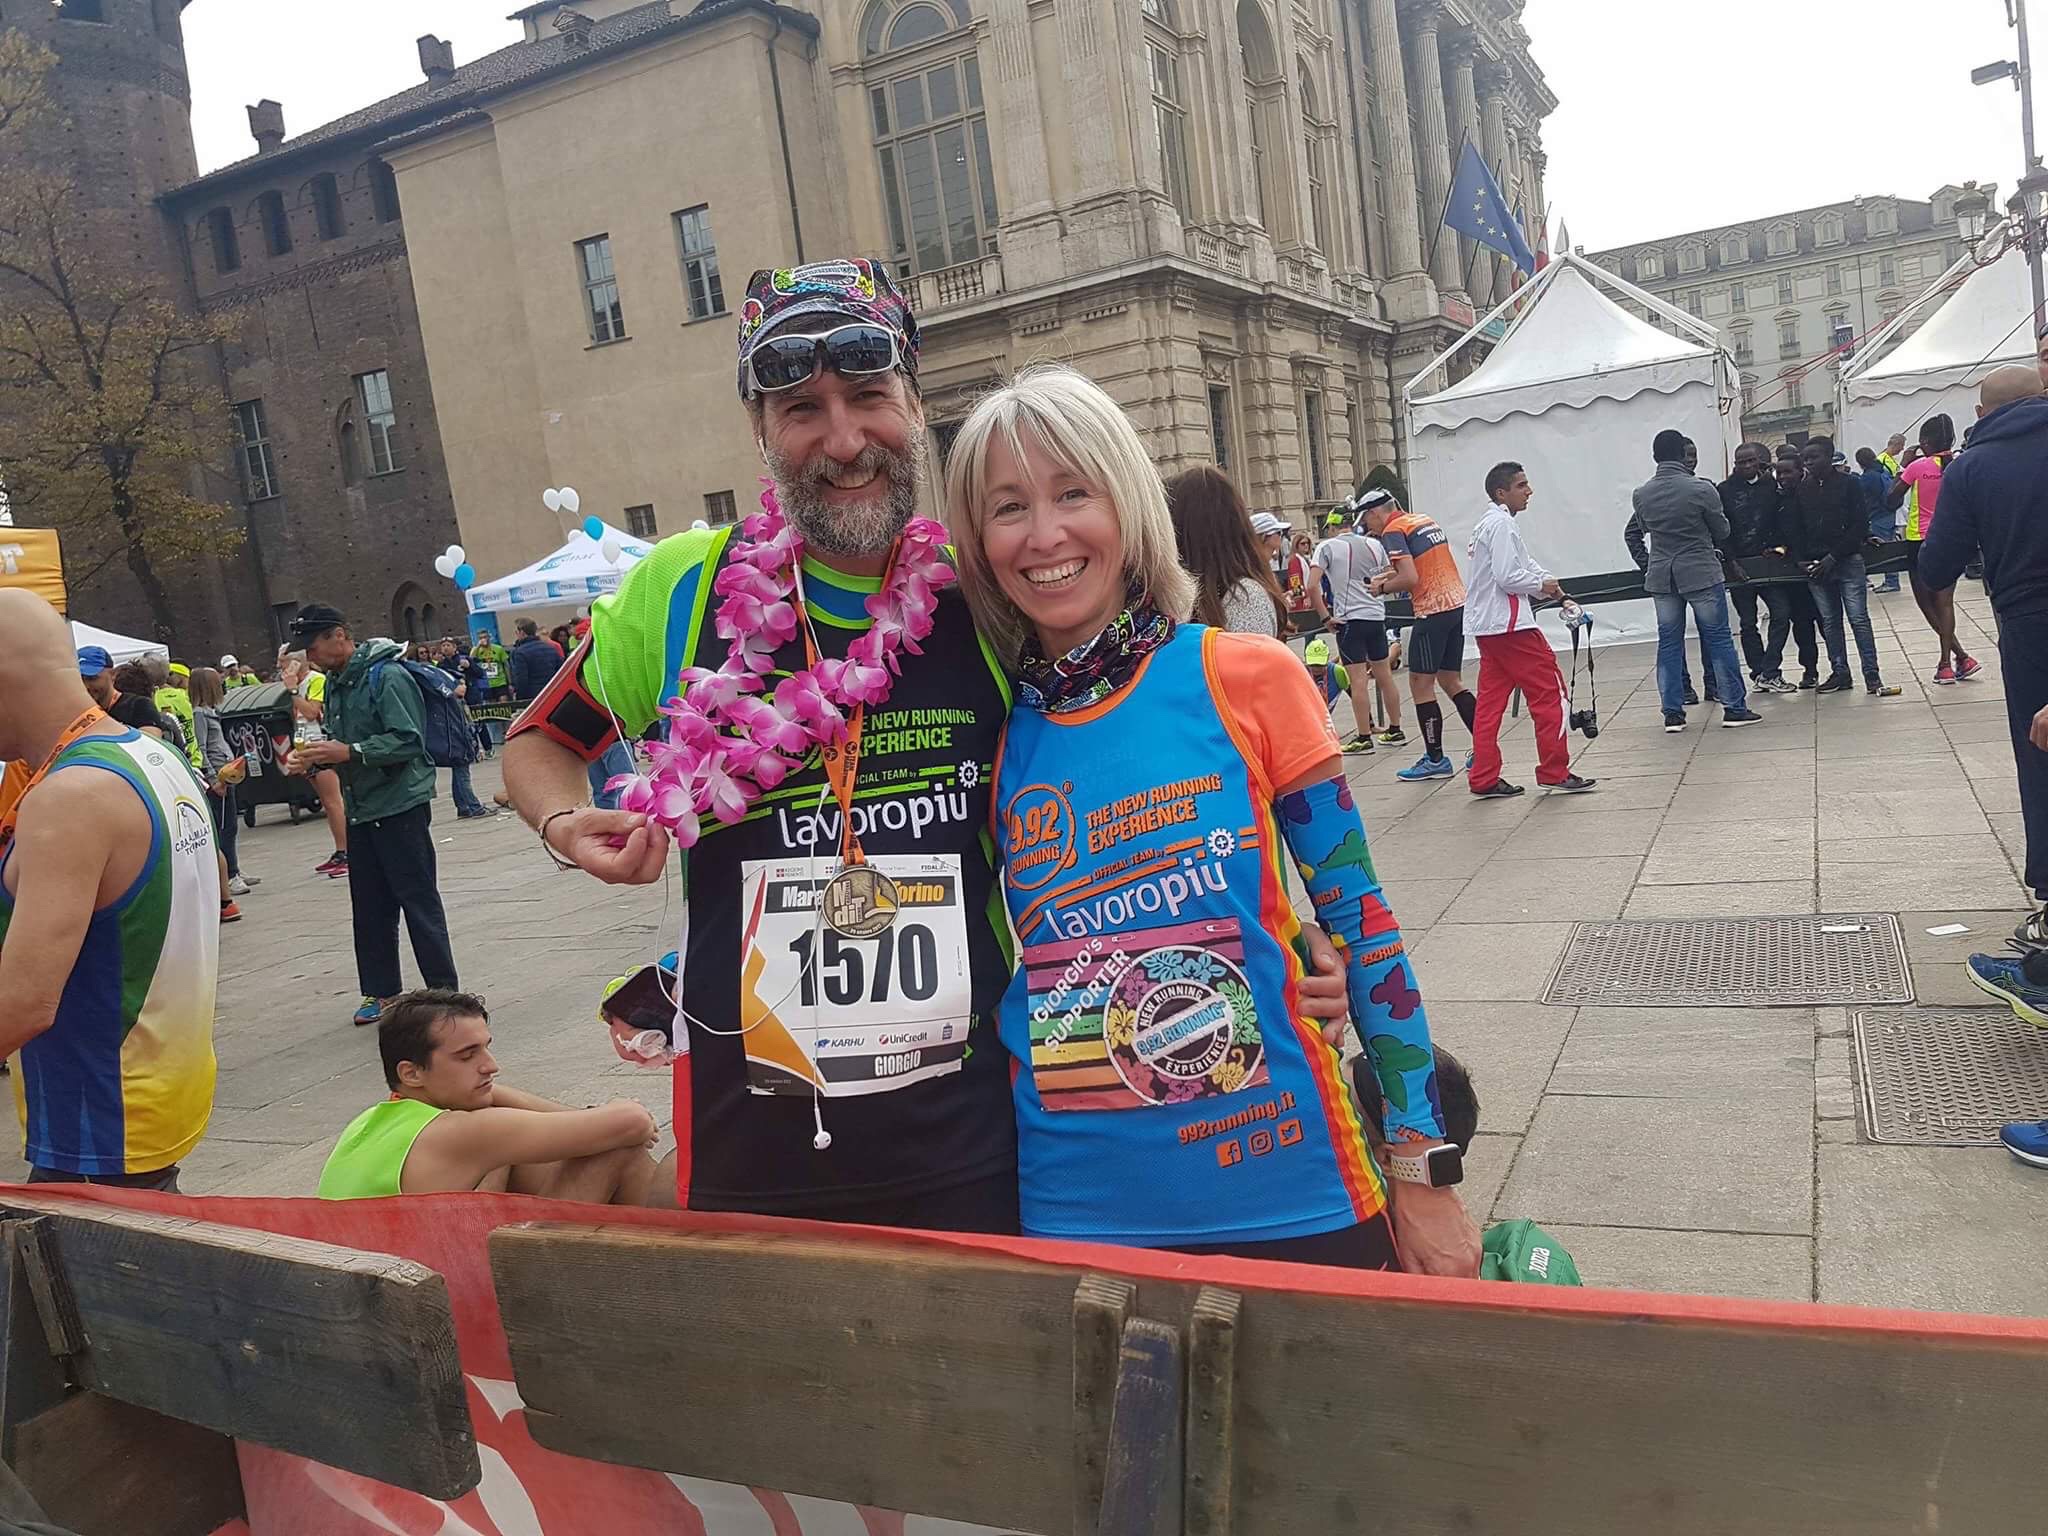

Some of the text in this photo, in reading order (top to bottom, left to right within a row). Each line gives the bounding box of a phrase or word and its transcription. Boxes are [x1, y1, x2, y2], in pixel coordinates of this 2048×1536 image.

[871, 710, 909, 731] NEW
[911, 708, 976, 726] RUNNING
[882, 768, 908, 781] TEAM
[1085, 773, 1222, 830] THE NEW RUNNING
[1088, 798, 1198, 854] EXPERIENCE
[1011, 844, 1061, 877] RUNNING
[1093, 859, 1130, 880] OFFICIAL
[1131, 848, 1156, 864] TEAM
[789, 923, 939, 1006] 1570
[1044, 948, 1130, 1051] SUPPORTER
[1139, 985, 1204, 1026] NEW RUNNING
[831, 1038, 865, 1047] KARHU
[889, 1032, 928, 1044] UniCredit
[1165, 1034, 1227, 1074] EXPERIENCE
[874, 1050, 922, 1077] GIORGIO
[1178, 1091, 1296, 1145] 992running.it
